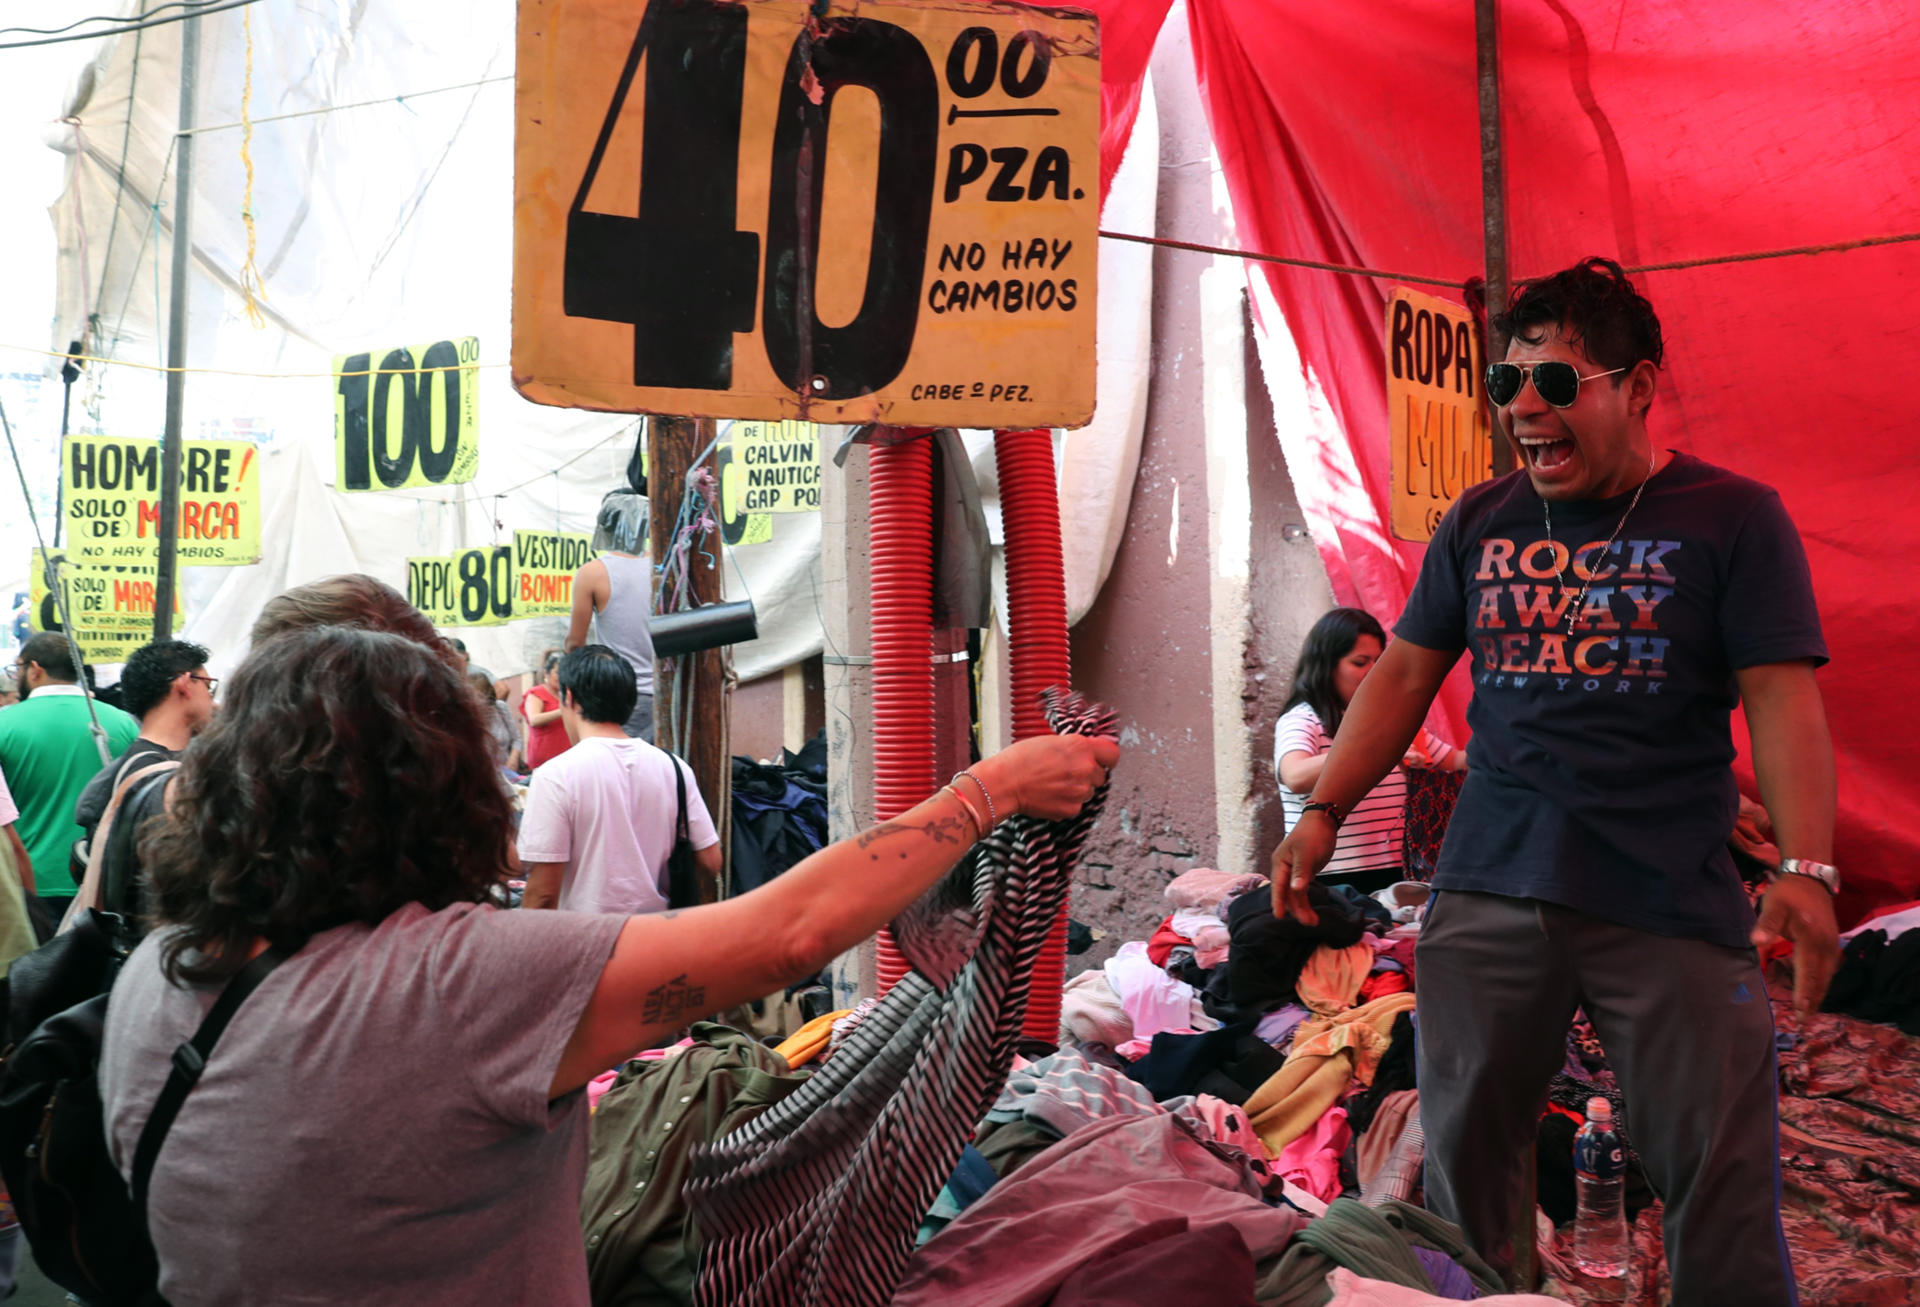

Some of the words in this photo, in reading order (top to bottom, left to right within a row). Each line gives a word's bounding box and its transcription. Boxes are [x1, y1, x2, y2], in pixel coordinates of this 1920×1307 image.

[944, 143, 1085, 203] PZA.
[563, 0, 939, 400] 40
[946, 26, 1052, 98] 00
[938, 242, 985, 272] NO
[1002, 238, 1072, 271] HAY
[928, 278, 1078, 313] CAMBIOS
[1392, 299, 1473, 398] ROPA
[911, 383, 964, 401] CABE
[338, 340, 461, 490] 100
[744, 426, 758, 437] DE
[71, 442, 255, 493] HOMRE!
[745, 443, 813, 465] CALVIN
[70, 499, 127, 519] SOLO
[746, 489, 780, 509] GAP
[81, 546, 104, 557] NO
[112, 546, 146, 557] HAY
[1475, 538, 1682, 584] ROCK
[73, 577, 106, 593] SOLO
[459, 546, 512, 622] 80
[1475, 584, 1675, 630] AWAY
[1475, 633, 1670, 677] BEACH
[1555, 677, 1662, 694] YORK
